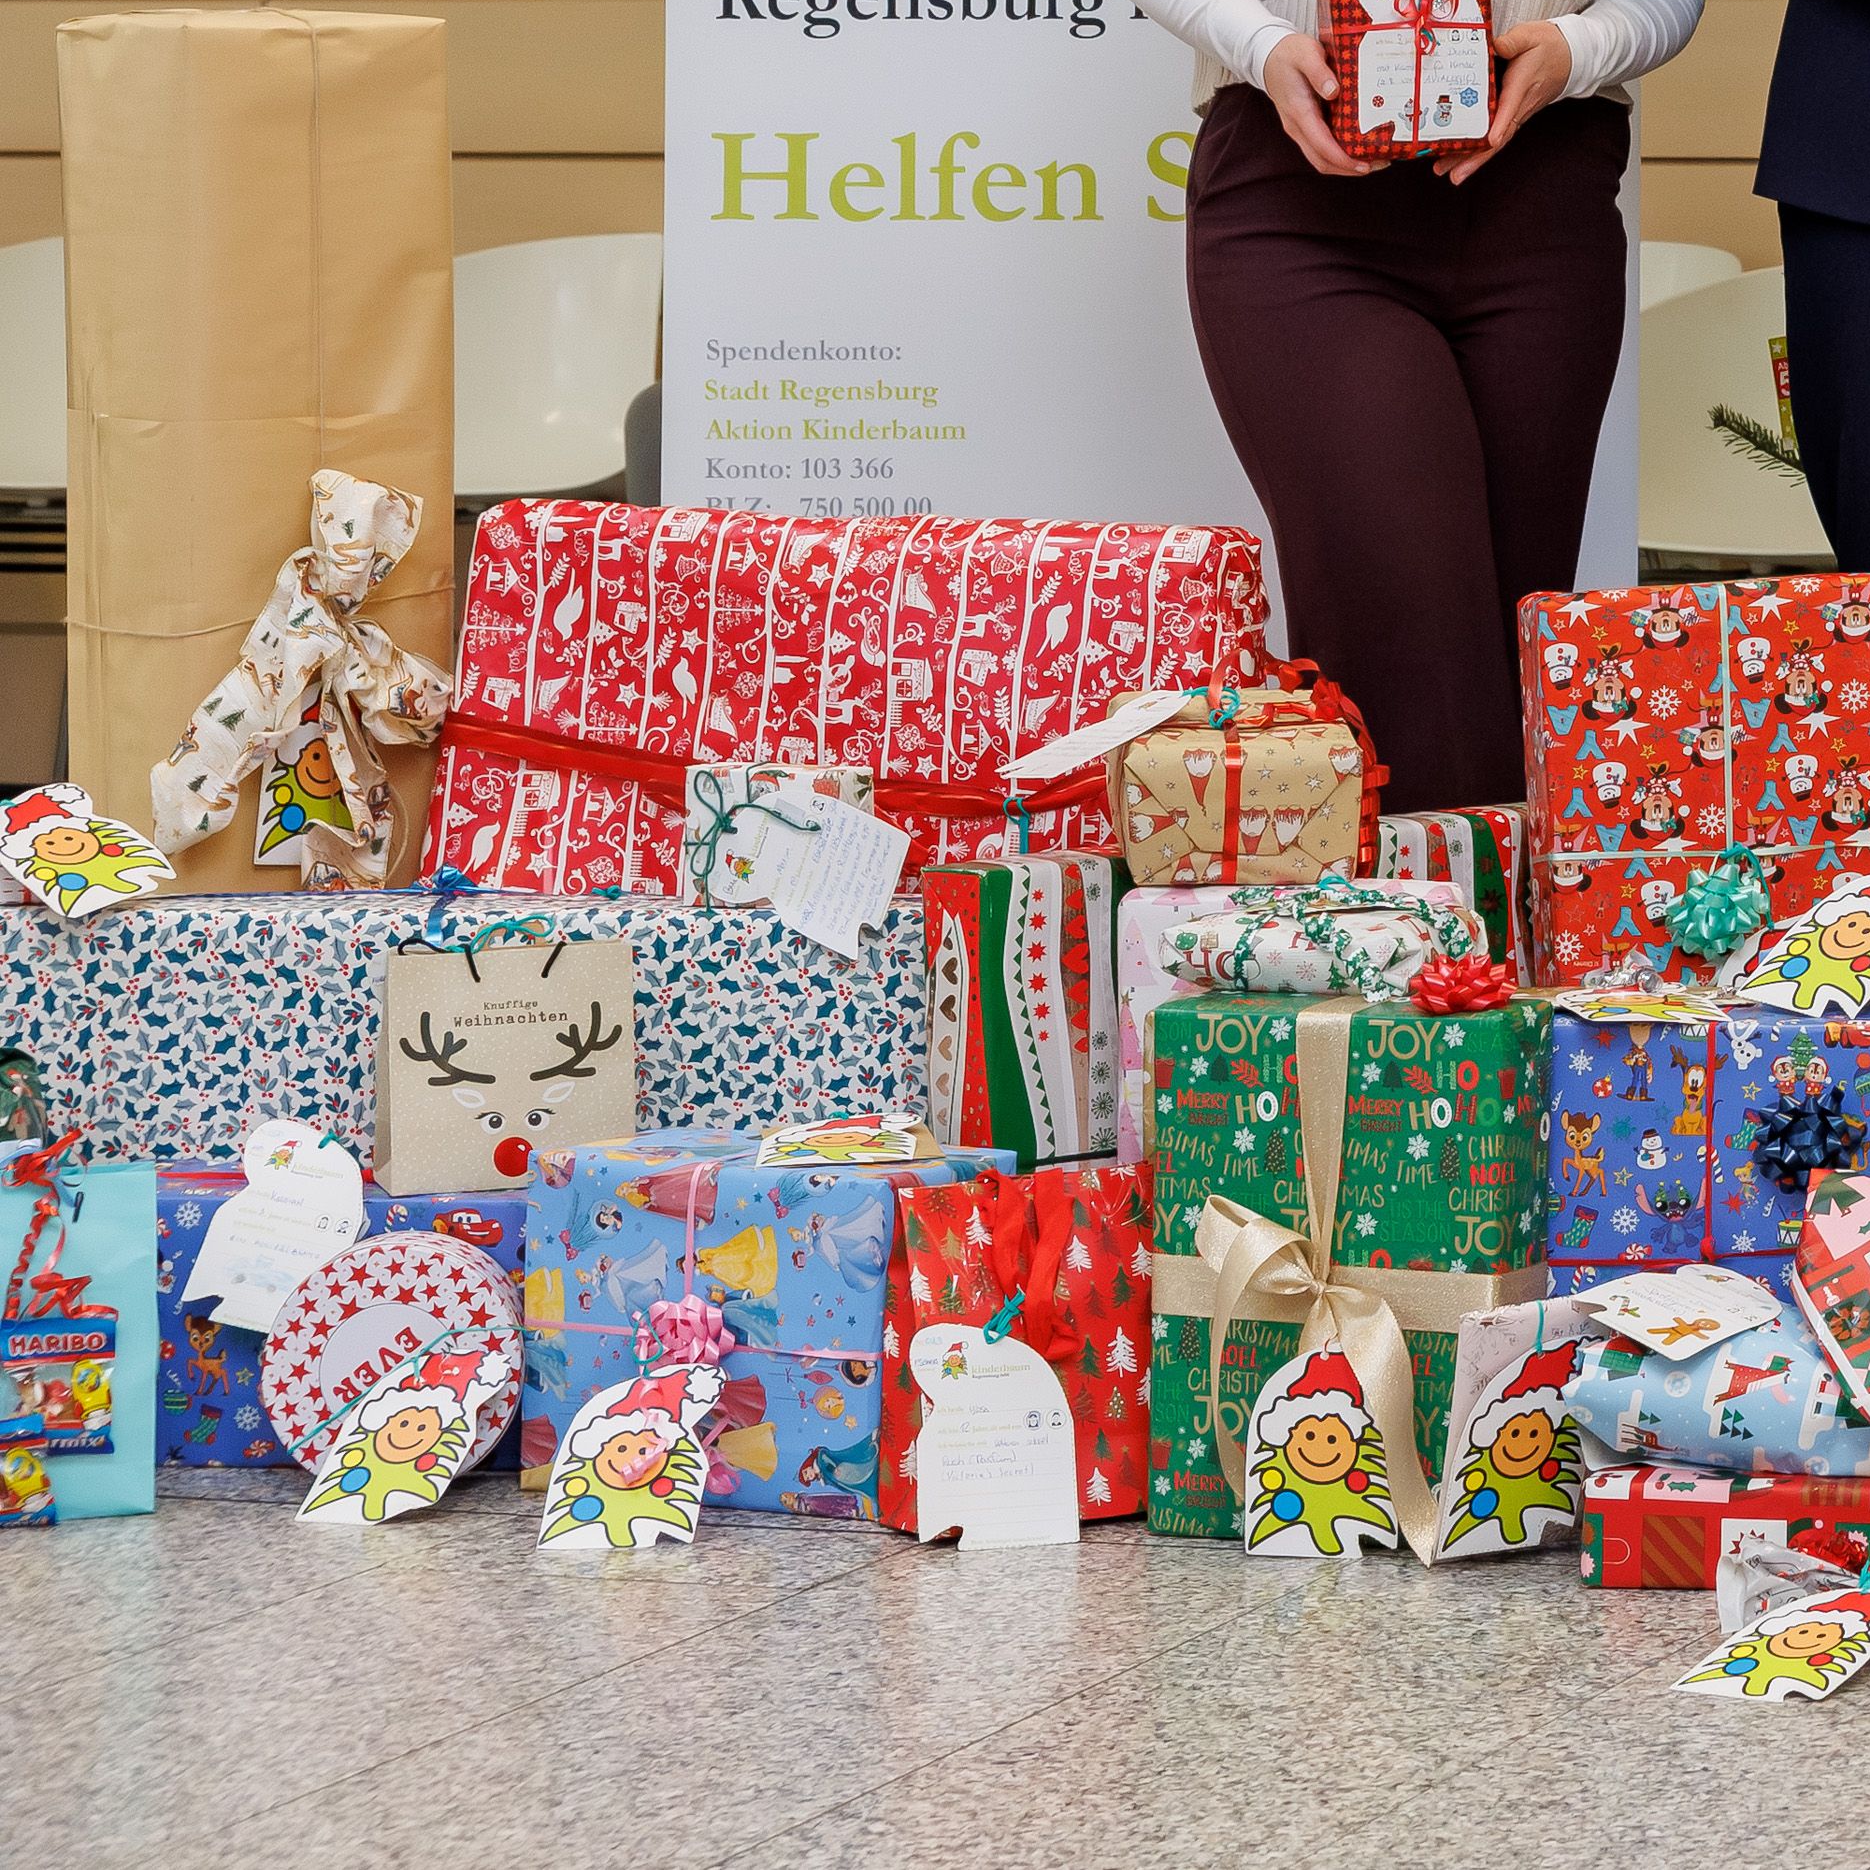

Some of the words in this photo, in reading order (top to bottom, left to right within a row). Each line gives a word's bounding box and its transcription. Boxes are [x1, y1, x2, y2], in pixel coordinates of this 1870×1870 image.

[710, 131, 1104, 224] Helfen
[706, 339, 901, 368] Spendenkonto:
[704, 379, 768, 401] Stadt
[780, 379, 939, 408] Regensburg
[705, 419, 792, 441] Aktion
[801, 419, 966, 441] Kinderbaum
[705, 458, 791, 479] Konto:
[801, 458, 842, 479] 103
[850, 457, 894, 479] 366
[800, 497, 843, 517] 750
[853, 497, 895, 517] 500
[903, 497, 932, 516] 00
[483, 1000, 538, 1010] Knuffige
[454, 1011, 568, 1028] Weihnachten
[1195, 1013, 1268, 1056] JOY
[1368, 1019, 1441, 1061] JOY
[1436, 1059, 1480, 1091] HO
[1177, 1089, 1231, 1110] MERRY
[1348, 1094, 1404, 1117] MERRY
[1224, 1153, 1263, 1183] TIME
[1396, 1159, 1438, 1191] TIME
[10, 1332, 106, 1356] HARIBO
[1173, 1469, 1226, 1493] MERRY
